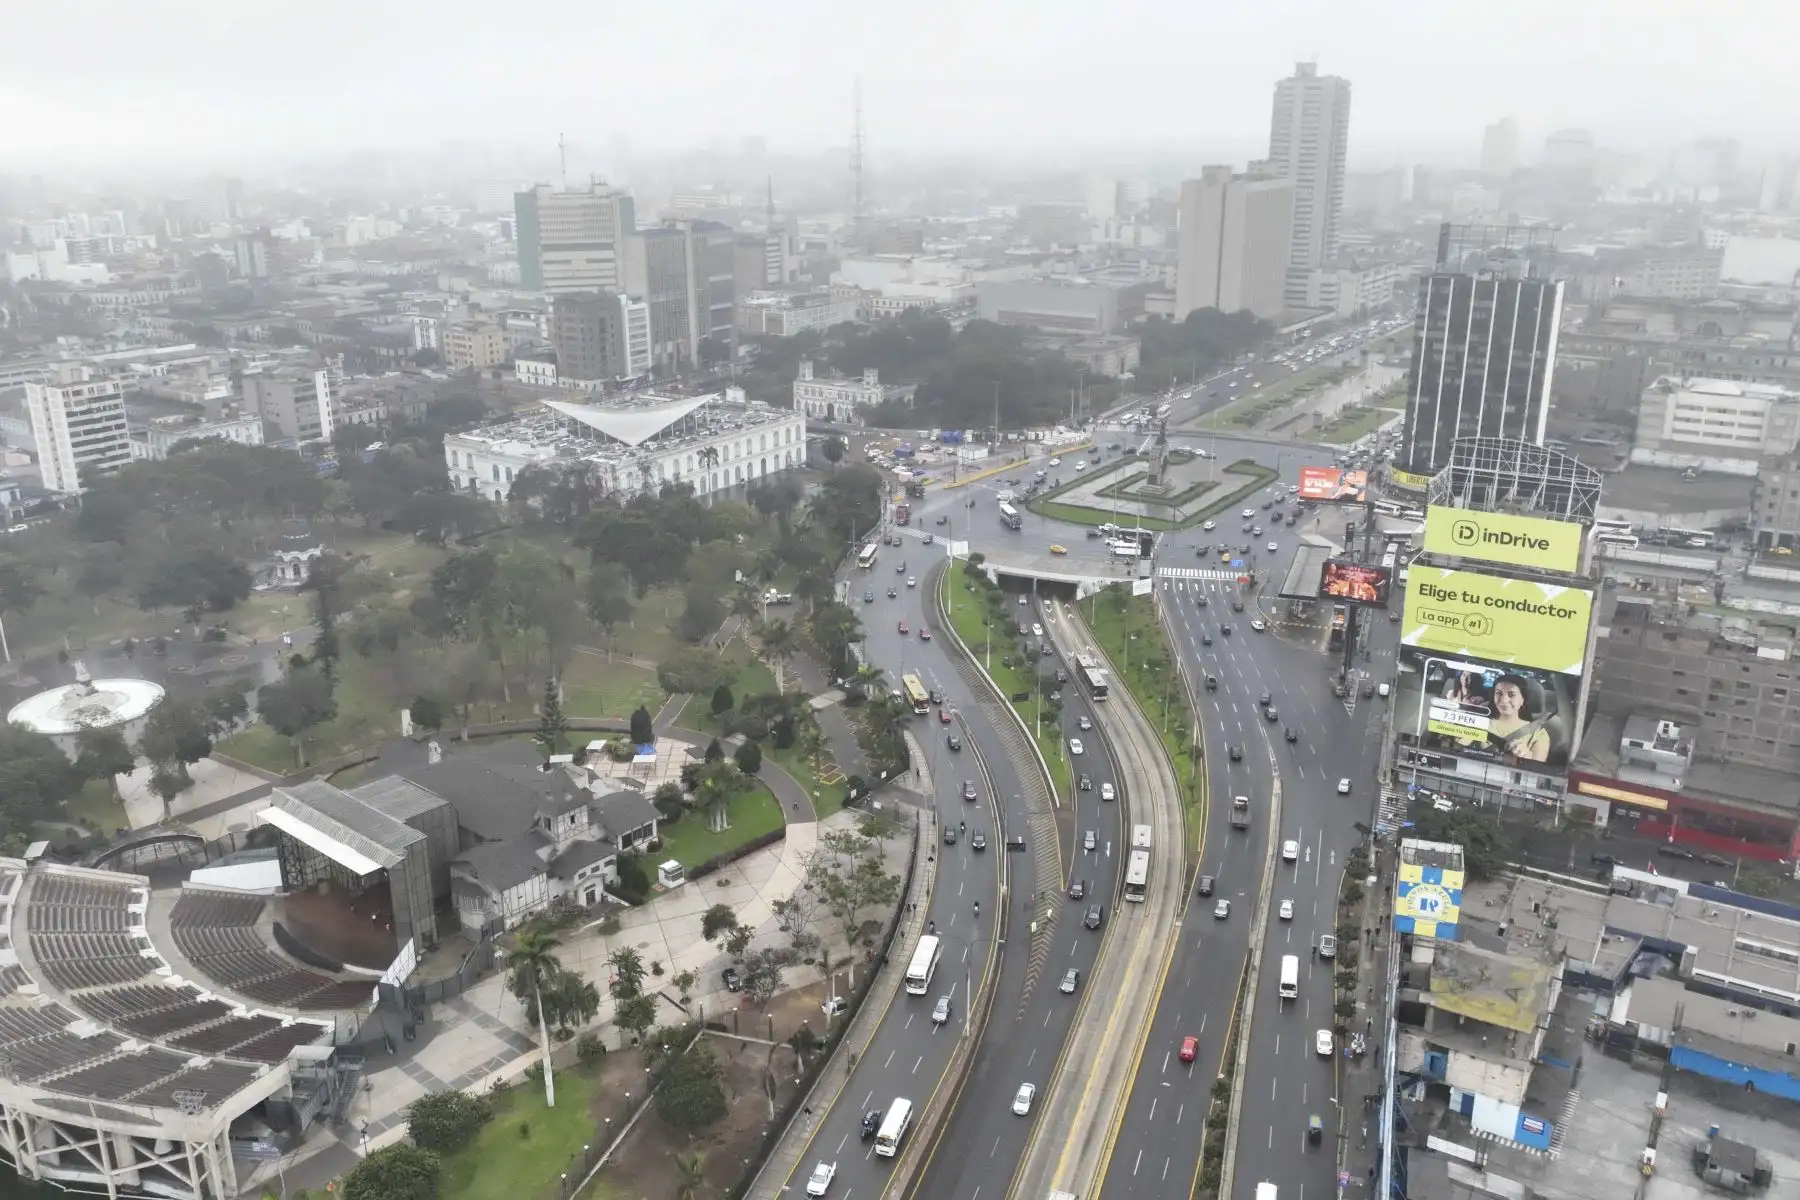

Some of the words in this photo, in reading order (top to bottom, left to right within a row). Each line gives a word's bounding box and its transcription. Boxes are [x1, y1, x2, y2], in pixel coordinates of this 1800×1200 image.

[1482, 527, 1550, 551] inDrive
[1419, 582, 1457, 602] Elige
[1461, 590, 1480, 604] tu
[1483, 596, 1577, 619] conductor
[1422, 611, 1435, 621] La
[1437, 615, 1460, 627] app
[1468, 619, 1483, 630] #1
[1458, 715, 1476, 725] PEN
